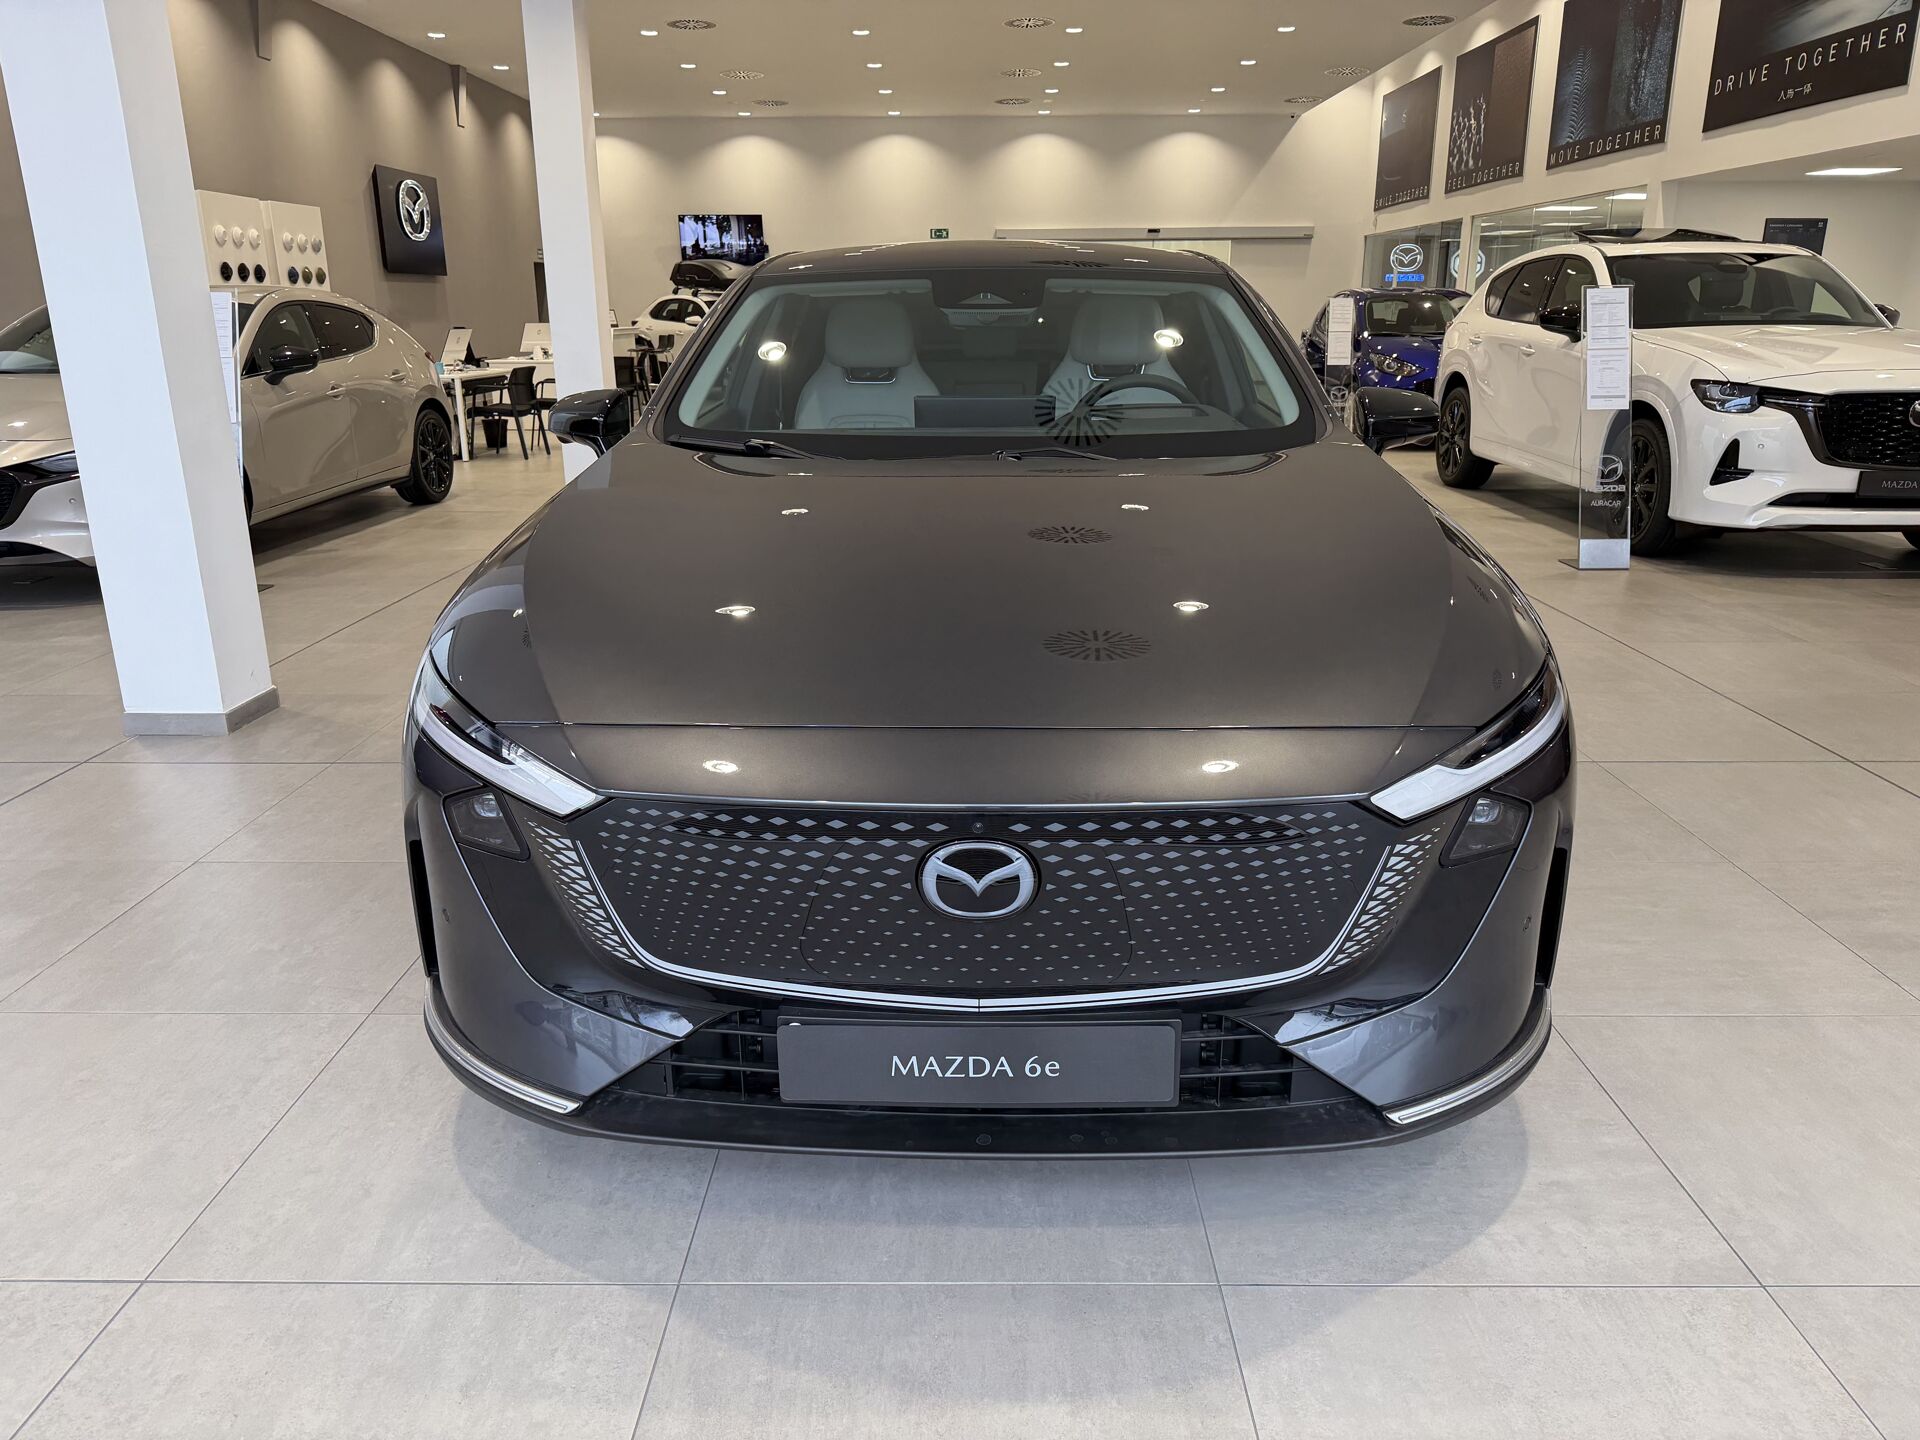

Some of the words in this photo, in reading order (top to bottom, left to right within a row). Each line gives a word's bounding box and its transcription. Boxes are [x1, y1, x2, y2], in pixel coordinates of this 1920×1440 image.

[1713, 63, 1770, 96] DRIVE
[1784, 23, 1907, 75] TOGETHER
[1549, 145, 1580, 166] MOVE
[1588, 124, 1661, 155] TOGETHER
[1447, 176, 1467, 191] FEEL
[1472, 162, 1520, 184] TOGETHER
[1375, 195, 1393, 209] SMILE
[1395, 185, 1428, 203] TOGETHER
[1881, 480, 1918, 489] MAZDA
[891, 1055, 1014, 1078] MAZDA
[1024, 1055, 1060, 1078] 6e
